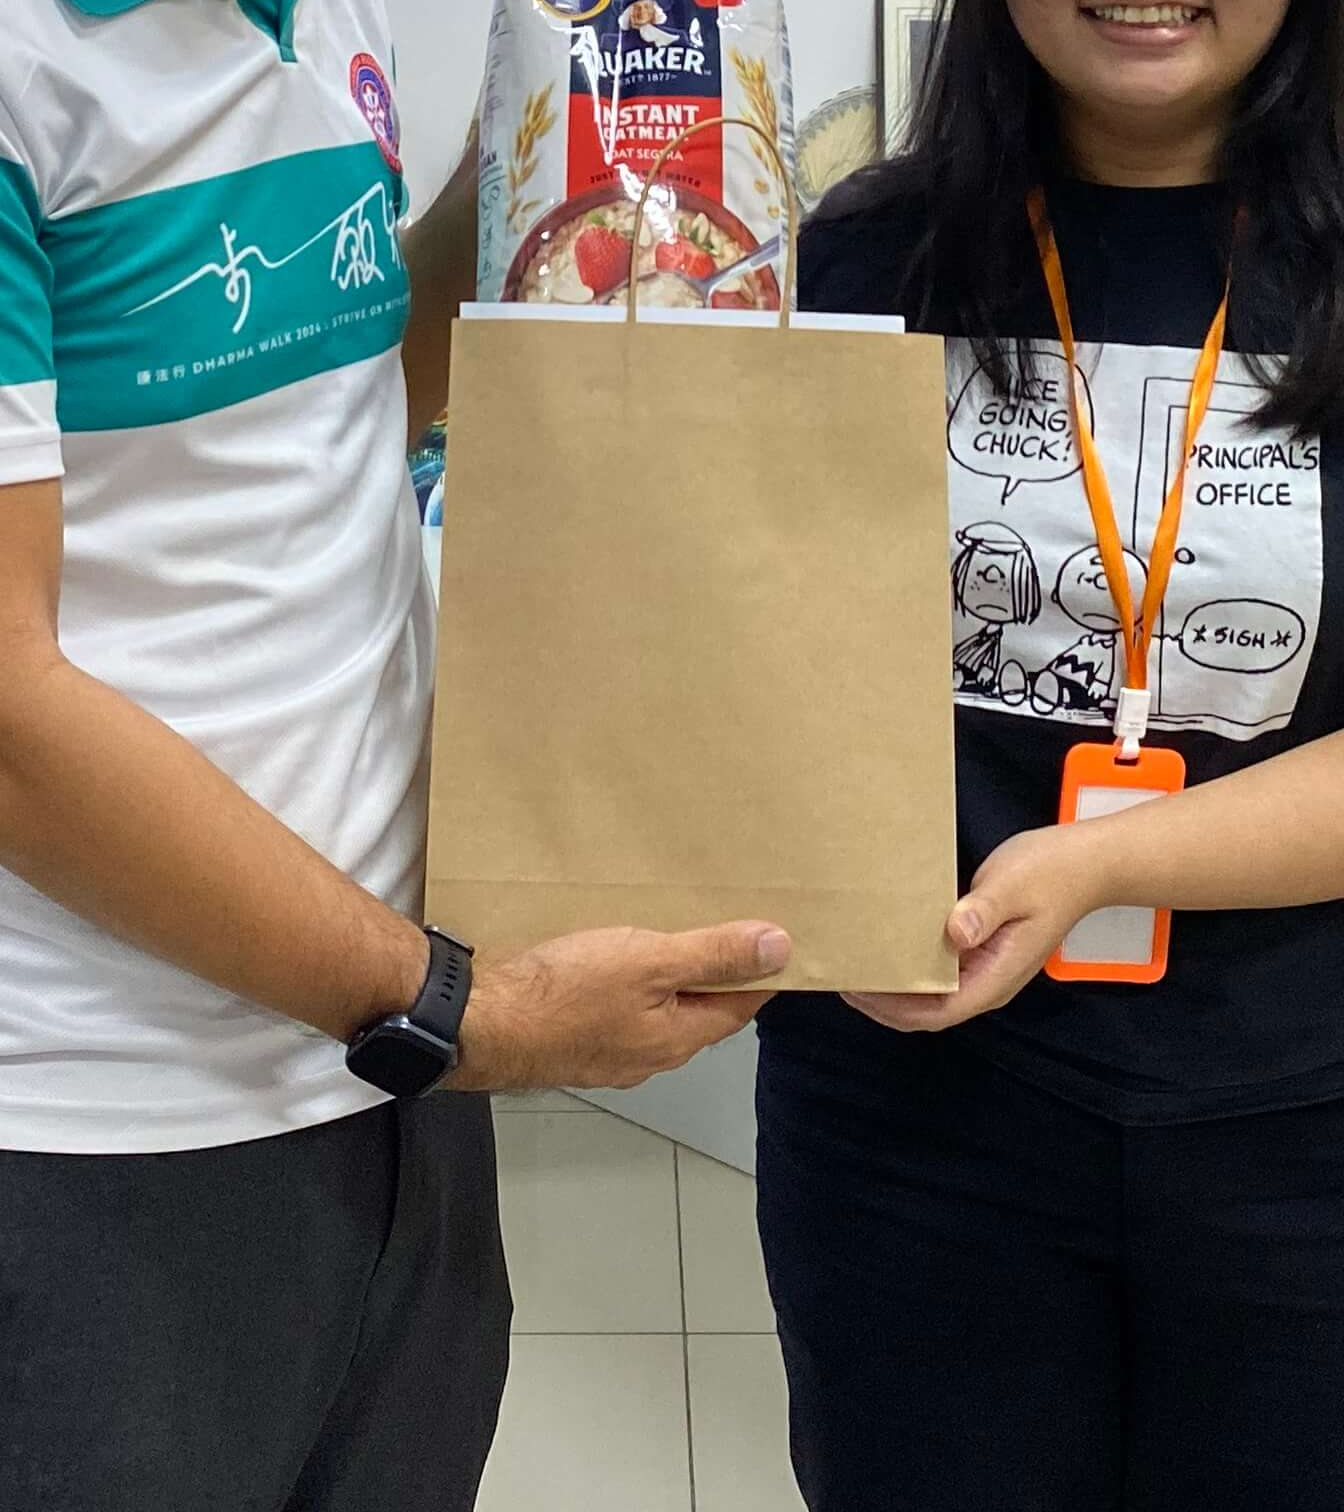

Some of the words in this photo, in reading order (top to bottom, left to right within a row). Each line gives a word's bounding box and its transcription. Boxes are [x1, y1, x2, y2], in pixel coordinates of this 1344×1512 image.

[647, 73, 672, 83] 1877
[596, 104, 700, 125] NSTANT
[636, 149, 684, 161] SEGRA
[192, 346, 255, 375] DHARMA
[258, 334, 293, 354] WALK
[296, 324, 322, 341] 2024
[331, 307, 367, 329] STRIVE
[973, 431, 1072, 462] CHUCK!
[1196, 482, 1292, 506] OFFICE
